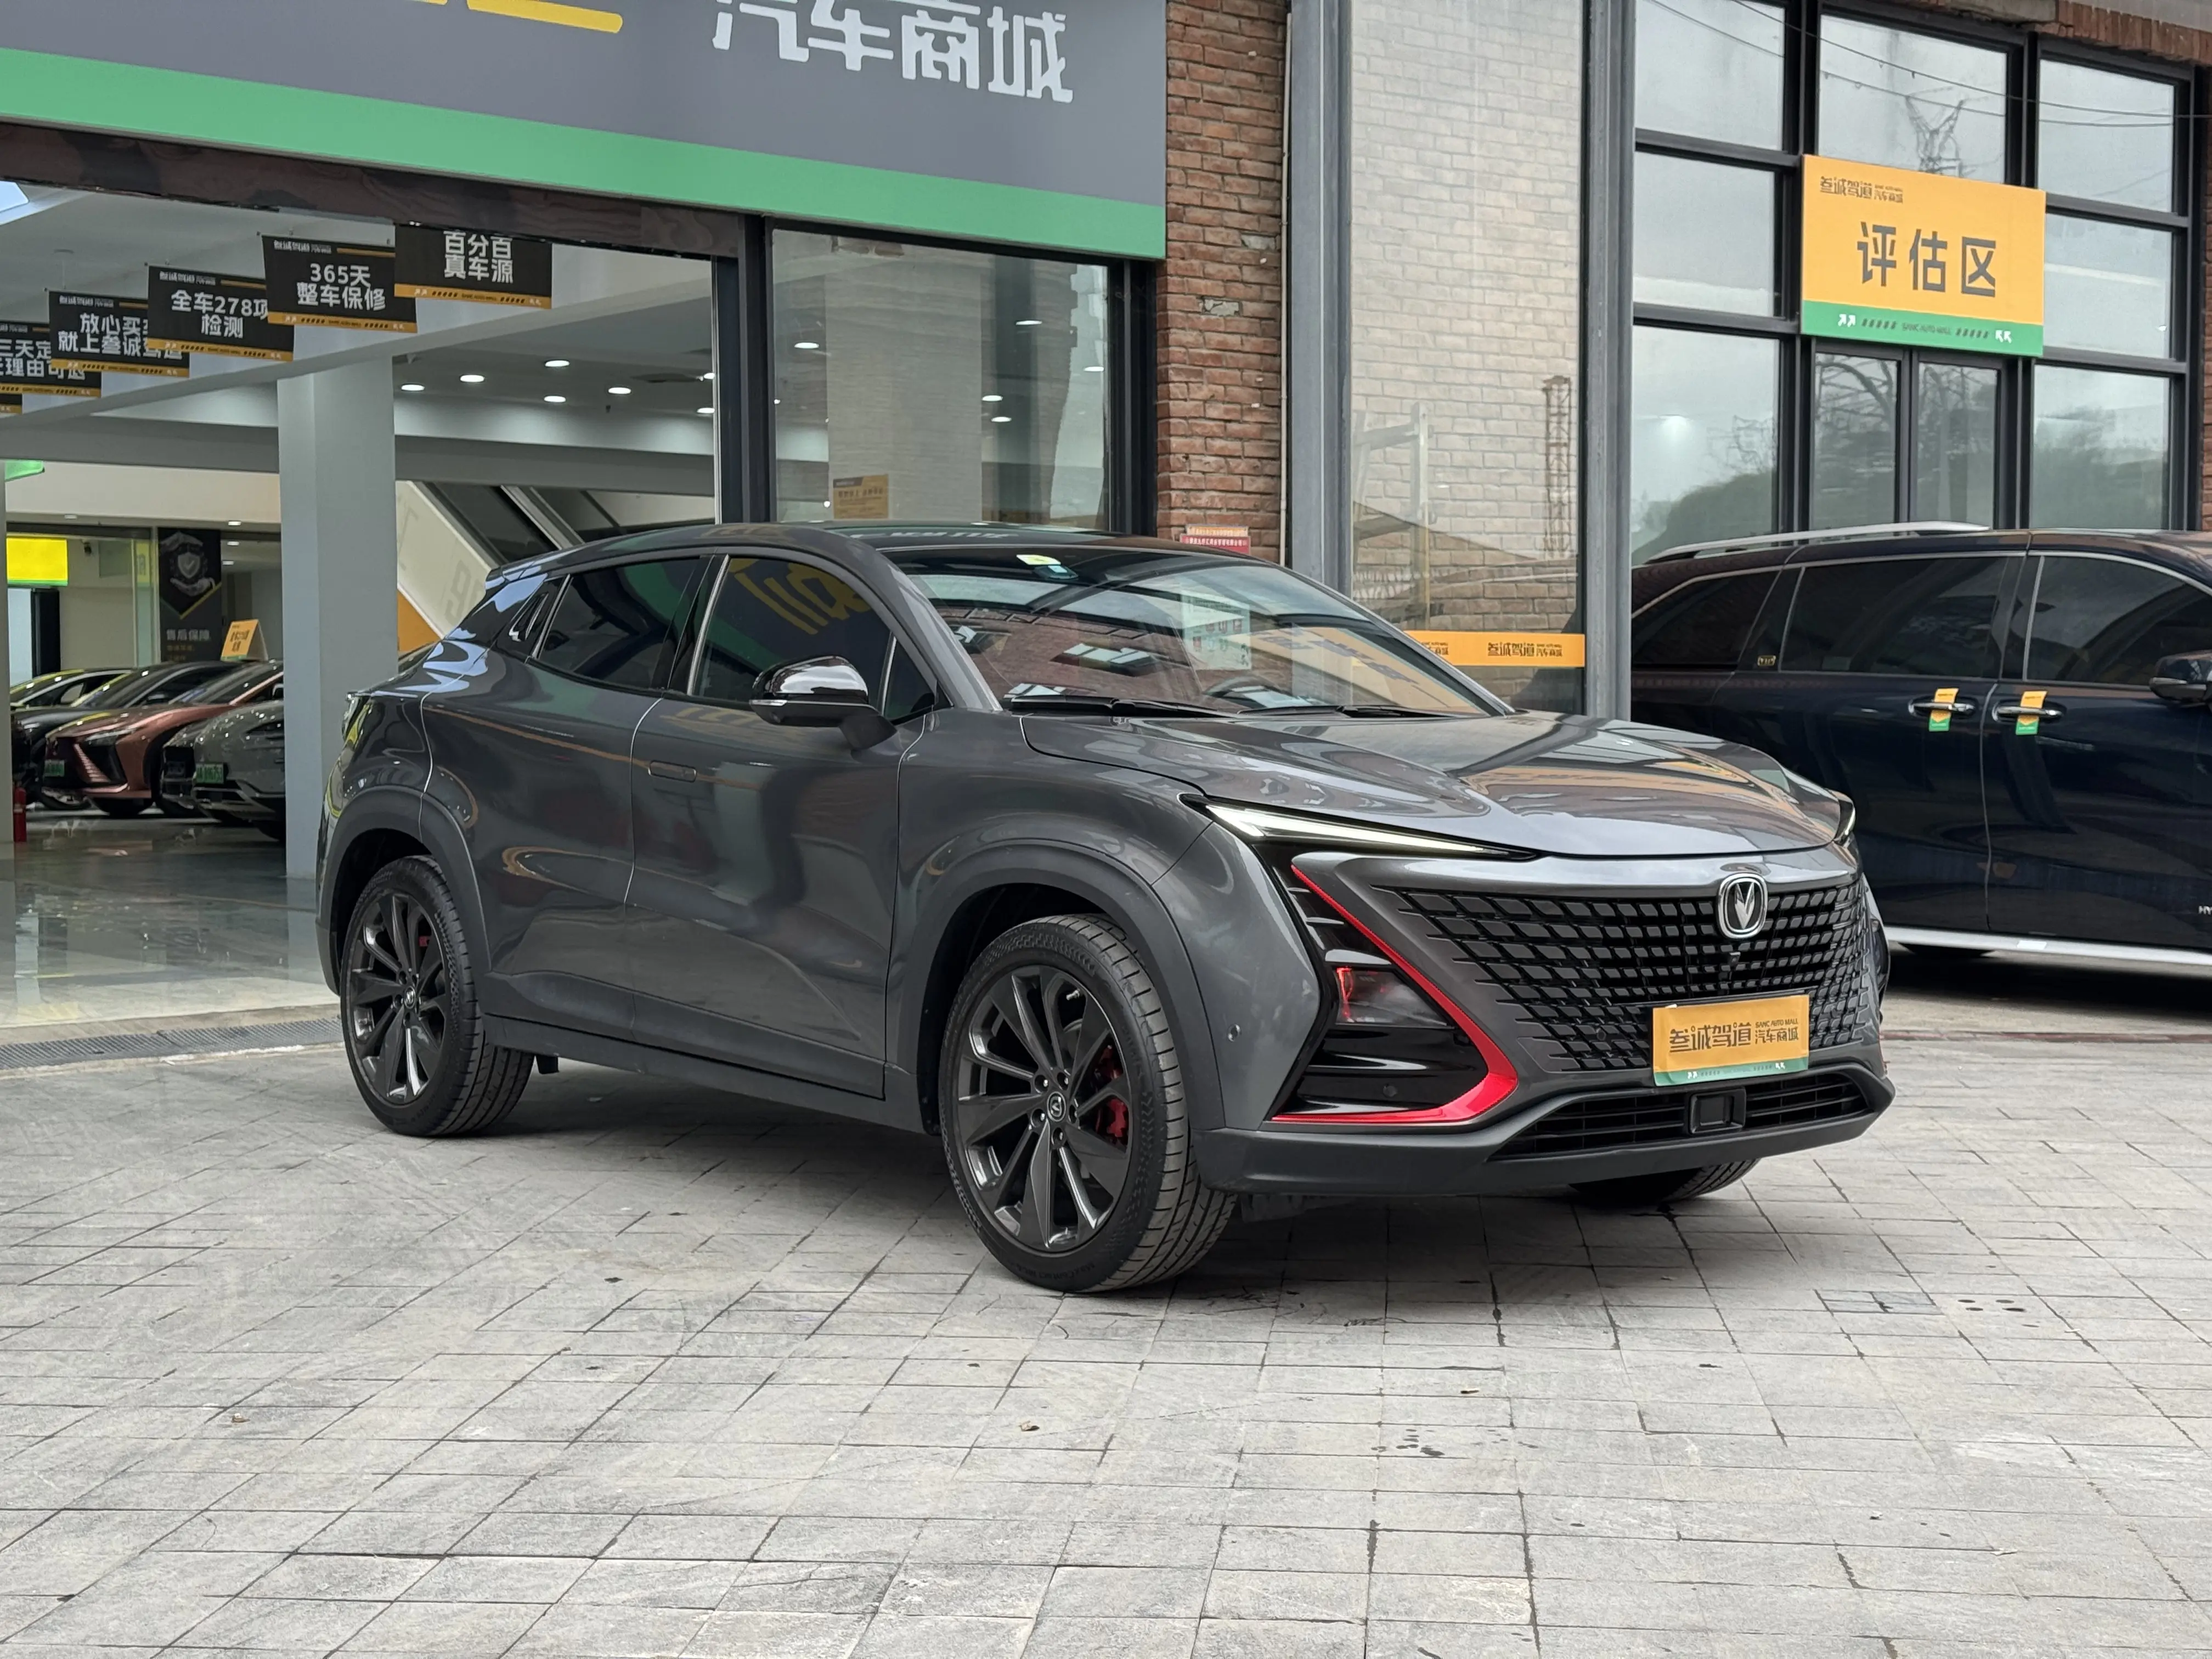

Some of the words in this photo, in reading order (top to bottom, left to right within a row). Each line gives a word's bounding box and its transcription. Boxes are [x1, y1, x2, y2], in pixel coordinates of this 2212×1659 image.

[443, 230, 513, 259] 百分百
[444, 254, 514, 284] 真车源
[1857, 221, 1996, 298] 评估区
[310, 263, 371, 288] 365天
[171, 289, 268, 320] 全车278项
[297, 281, 386, 311] 整车保修
[80, 312, 148, 335] 放心买
[201, 313, 244, 338] 检测
[2199, 906, 2212, 916] HY
[1669, 1022, 1752, 1053] 叁诚驾道
[1755, 1026, 1799, 1045] 汽车商城
[1755, 1020, 1770, 1029] SANC
